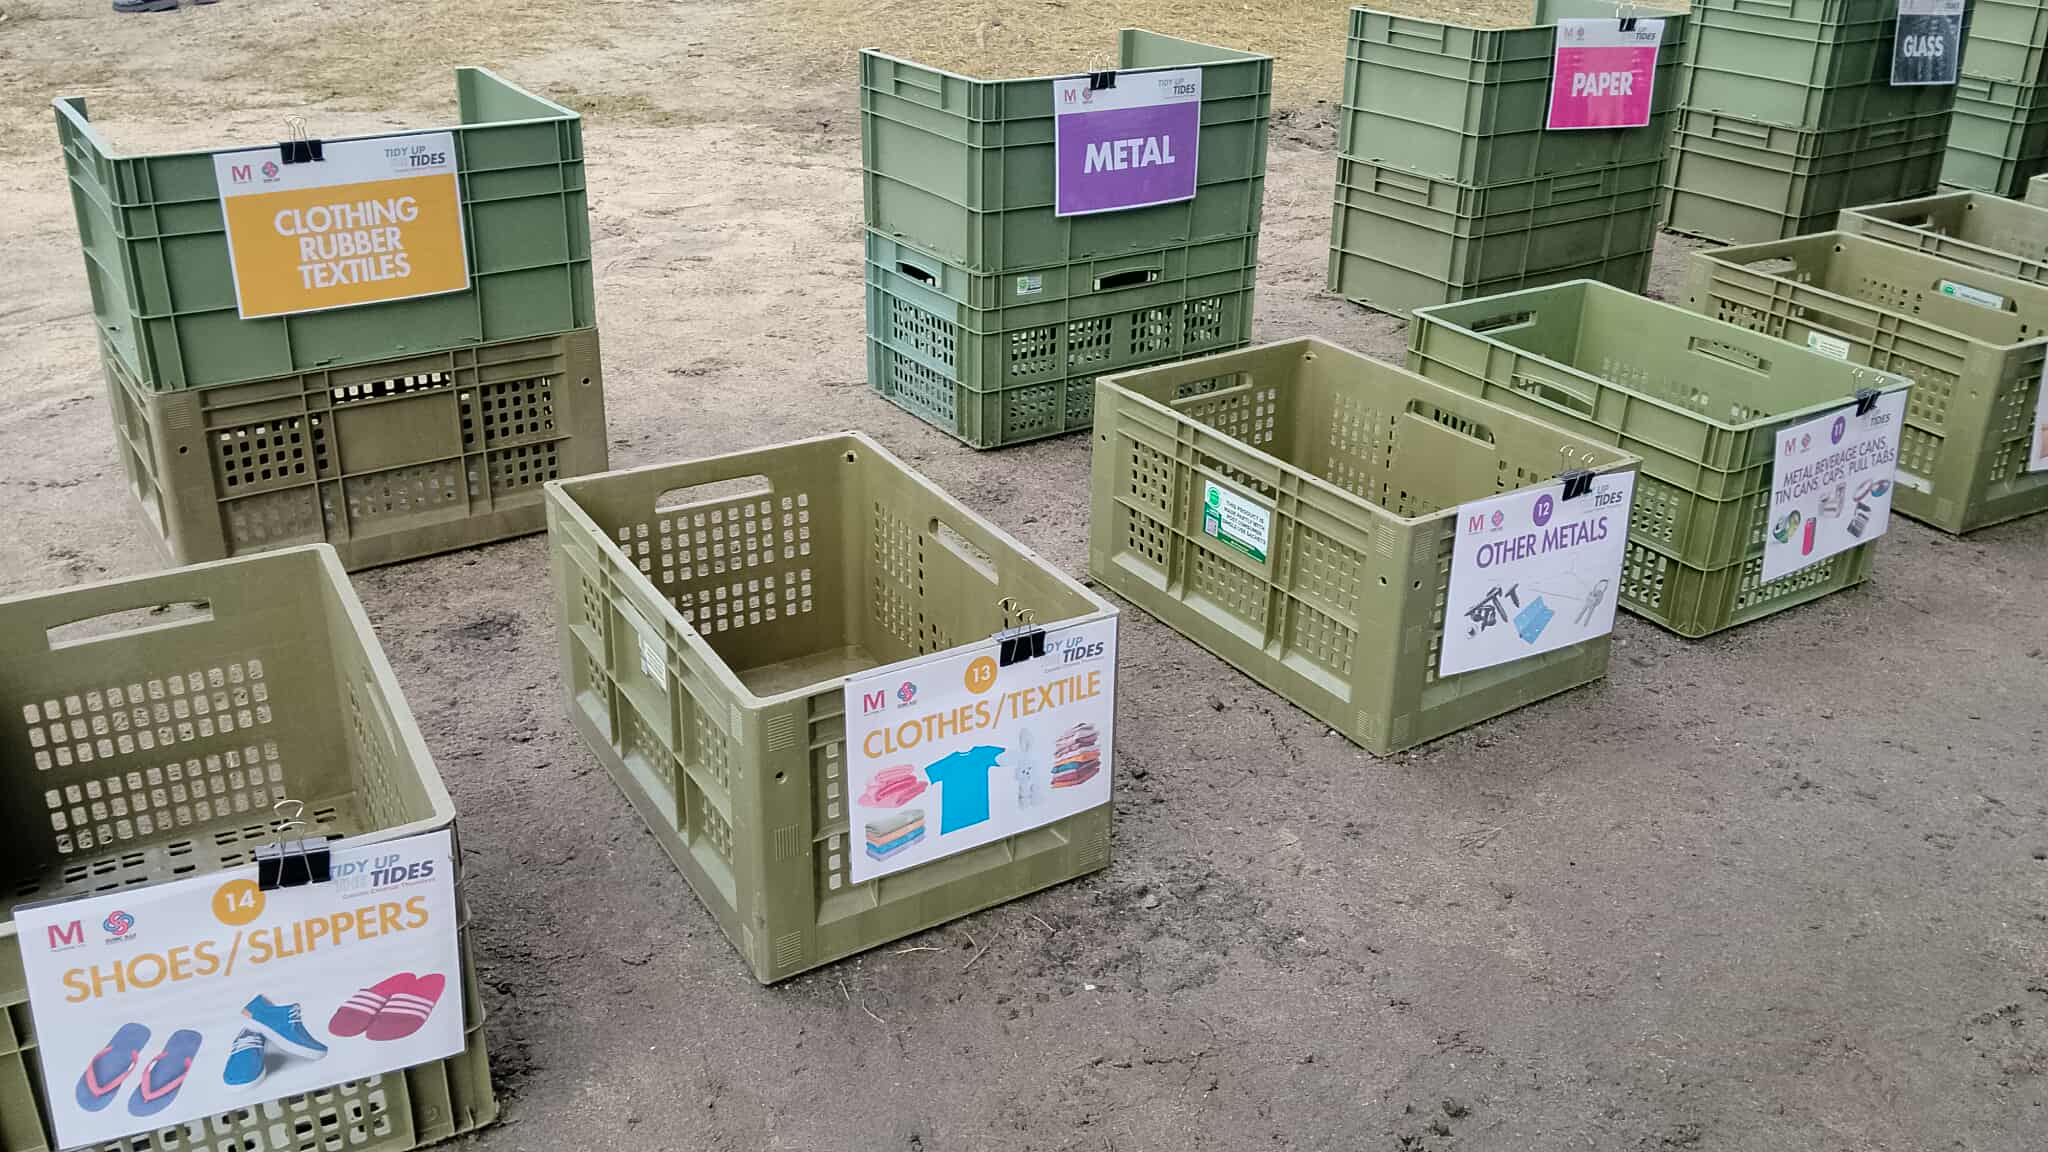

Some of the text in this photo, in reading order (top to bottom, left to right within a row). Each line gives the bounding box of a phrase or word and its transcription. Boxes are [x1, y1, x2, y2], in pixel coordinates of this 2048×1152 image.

[1903, 35, 1944, 57] GLASS
[1064, 89, 1077, 102] M
[1173, 83, 1196, 95] TIDES
[1571, 71, 1633, 97] PAPER
[384, 145, 426, 158] TIDY UP
[409, 152, 446, 167] TIDES
[1084, 135, 1176, 174] METAL
[231, 164, 252, 183] M
[274, 195, 419, 237] CLOTHING
[299, 226, 405, 262] RUBBER
[297, 252, 411, 290] TEXTILES
[1775, 486, 1792, 505] TIN
[1849, 457, 1868, 475] PULL
[1871, 447, 1896, 466] TABS
[1784, 465, 1815, 487] METAL
[1815, 444, 1858, 476] BEVERAGE
[1538, 502, 1550, 517] 12
[1594, 491, 1624, 507] TIDES
[1468, 514, 1485, 533] M
[1476, 516, 1609, 569] OTHER METALS
[1046, 636, 1084, 654] DY UP
[1063, 641, 1105, 663] TIDES
[972, 665, 992, 683] 13
[863, 689, 886, 714] M
[863, 671, 1101, 759] CLOTHES/TEXTILE
[374, 854, 401, 869] UP
[370, 860, 434, 888] TIDES
[225, 889, 257, 913] 14
[47, 919, 85, 949] M
[62, 895, 429, 1004] SHOES/SLIPPERS
